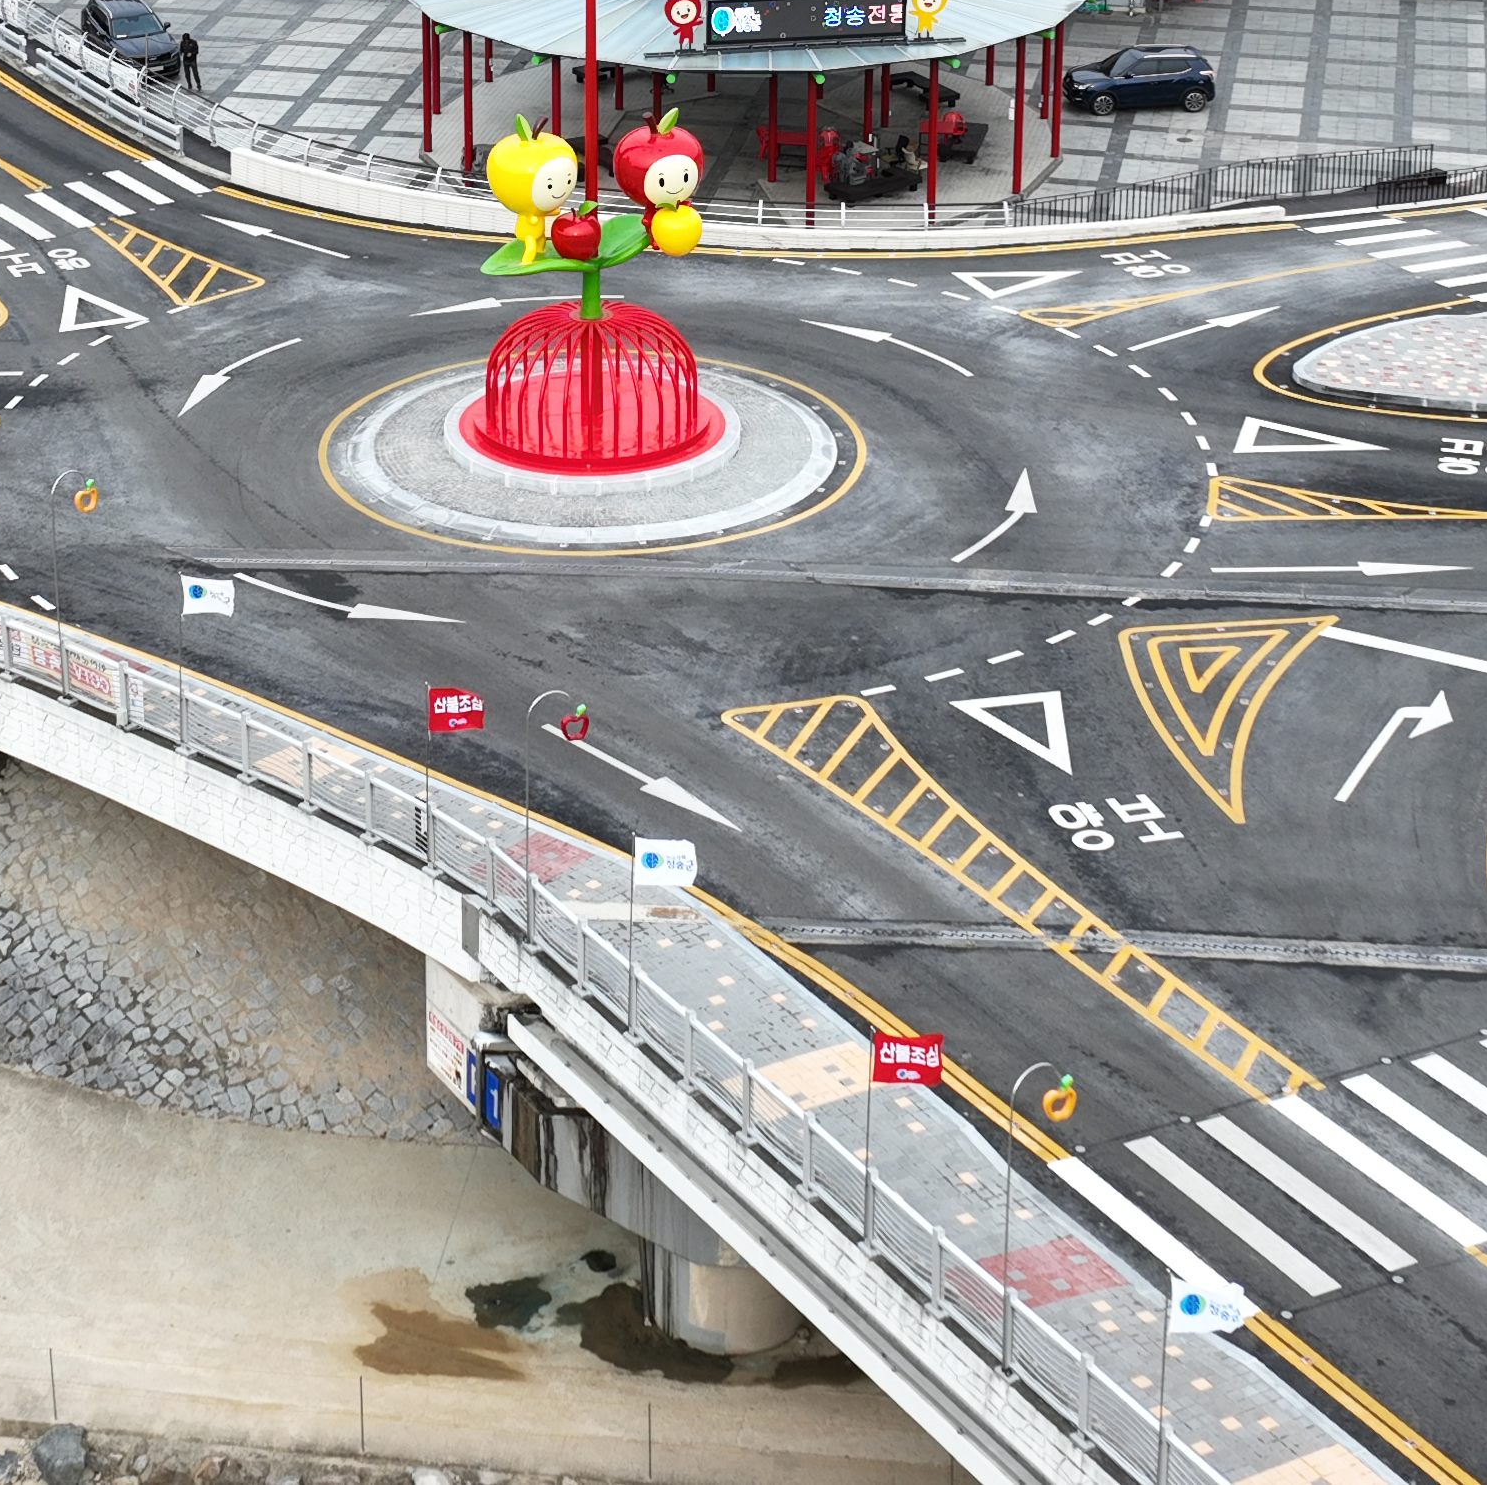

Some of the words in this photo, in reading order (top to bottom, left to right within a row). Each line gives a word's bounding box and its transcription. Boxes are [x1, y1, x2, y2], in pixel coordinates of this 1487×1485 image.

[0, 247, 92, 278] 양보
[1100, 249, 1191, 279] 양보
[432, 696, 484, 714] 산불조심
[1047, 793, 1185, 851] 양보
[879, 1044, 940, 1067] 산불조심
